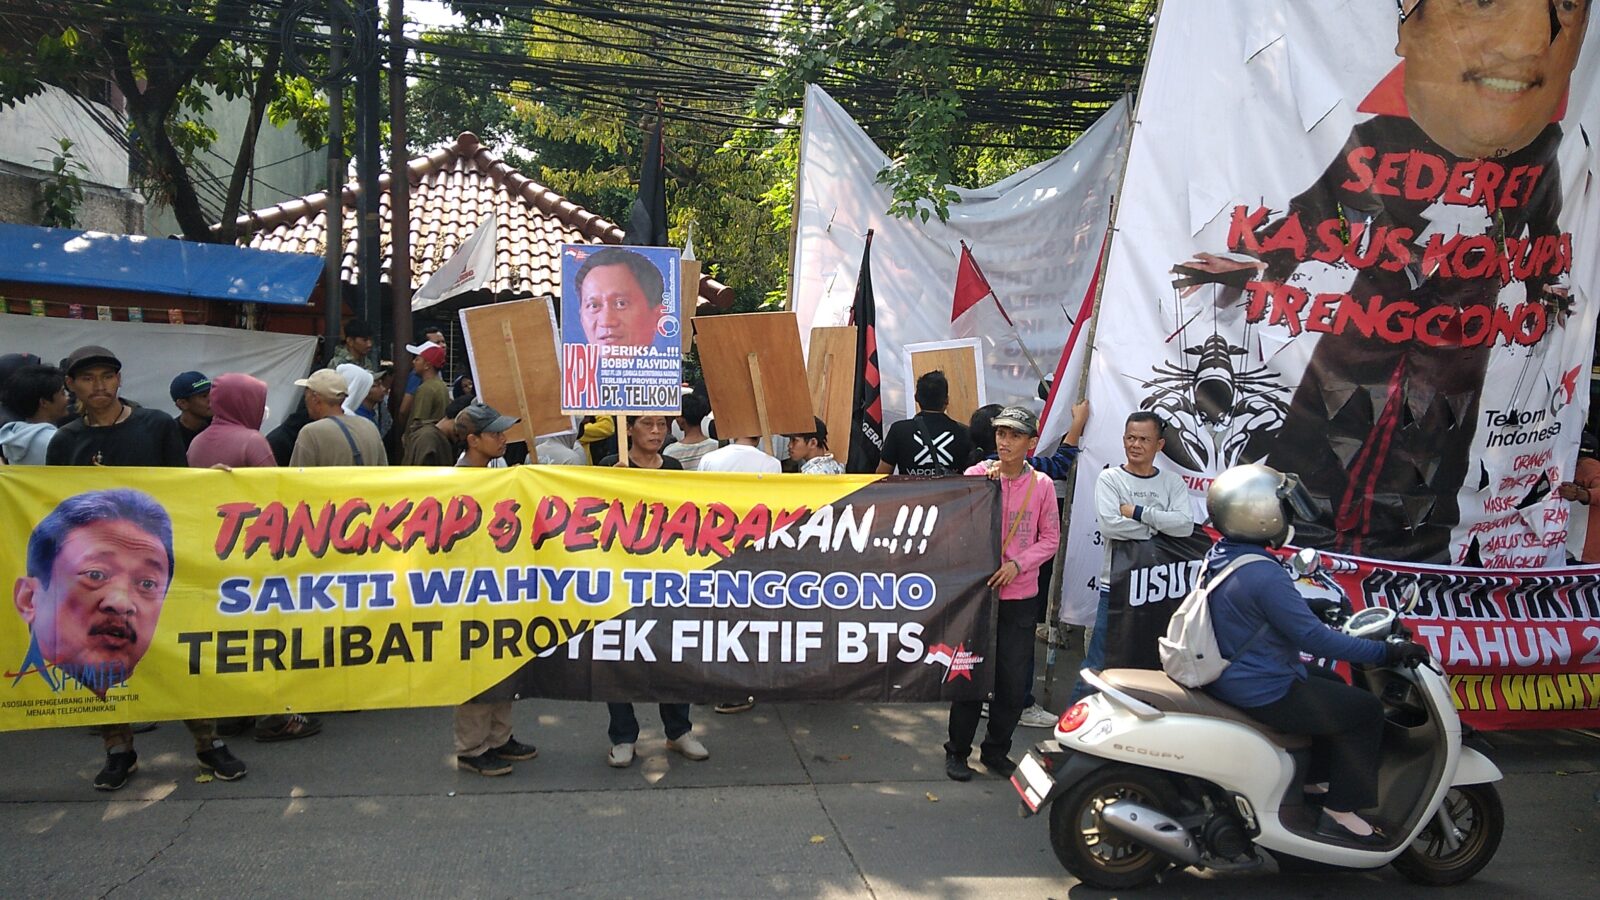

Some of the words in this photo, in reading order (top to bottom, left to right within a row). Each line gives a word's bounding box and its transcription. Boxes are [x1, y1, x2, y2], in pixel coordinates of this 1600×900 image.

[1341, 146, 1544, 214] SEDERET
[1227, 204, 1414, 272] KASUS
[1421, 231, 1573, 285] KORUPSI
[1245, 280, 1548, 348] TRENGGONO
[563, 343, 600, 408] KPK
[601, 358, 635, 369] BOBBY
[636, 358, 680, 370] RASYIDIN
[601, 384, 623, 407] PT.
[624, 384, 680, 408] TELKOM
[1485, 408, 1547, 427] Teom
[1486, 421, 1562, 449] Indonesa
[1182, 475, 1214, 492] FIKT
[213, 494, 483, 560] TANGKAP
[487, 497, 519, 553] &
[218, 571, 396, 616] SAKTI
[407, 566, 613, 608] WAHYU
[623, 568, 938, 612] TRENGGONO
[1129, 559, 1204, 607] USUT
[1361, 566, 1506, 622] PROYEK
[1505, 574, 1600, 622] FIKTI
[178, 620, 443, 675] TERLIBAT
[460, 616, 657, 664] PROYEK
[671, 619, 824, 664] FIKTIF
[837, 621, 926, 664] BTS
[1418, 625, 1572, 667] TAHUN
[2, 699, 34, 709] ASOSIASI
[35, 697, 83, 707] PENGEMBANG
[84, 693, 140, 704] INFRASTRUKTUR
[25, 709, 56, 717] MENARA
[57, 705, 116, 716] TELEKOMUNIKASI
[1500, 672, 1600, 711] WAHY
